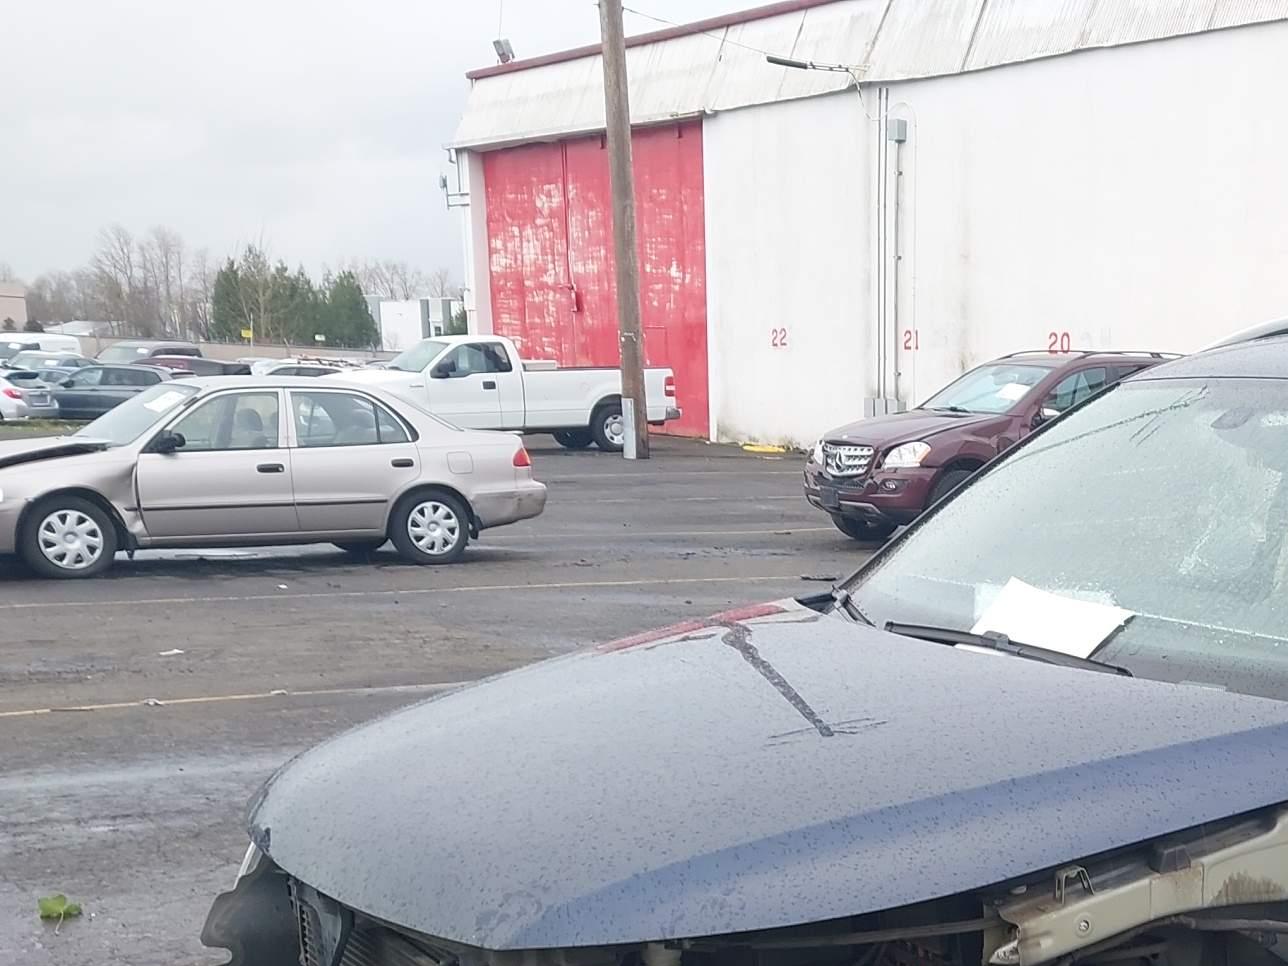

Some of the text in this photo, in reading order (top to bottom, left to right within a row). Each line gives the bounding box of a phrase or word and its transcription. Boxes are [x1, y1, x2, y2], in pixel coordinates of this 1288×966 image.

[771, 328, 788, 347] 22
[903, 329, 919, 350] 21
[1048, 332, 1071, 354] 20
